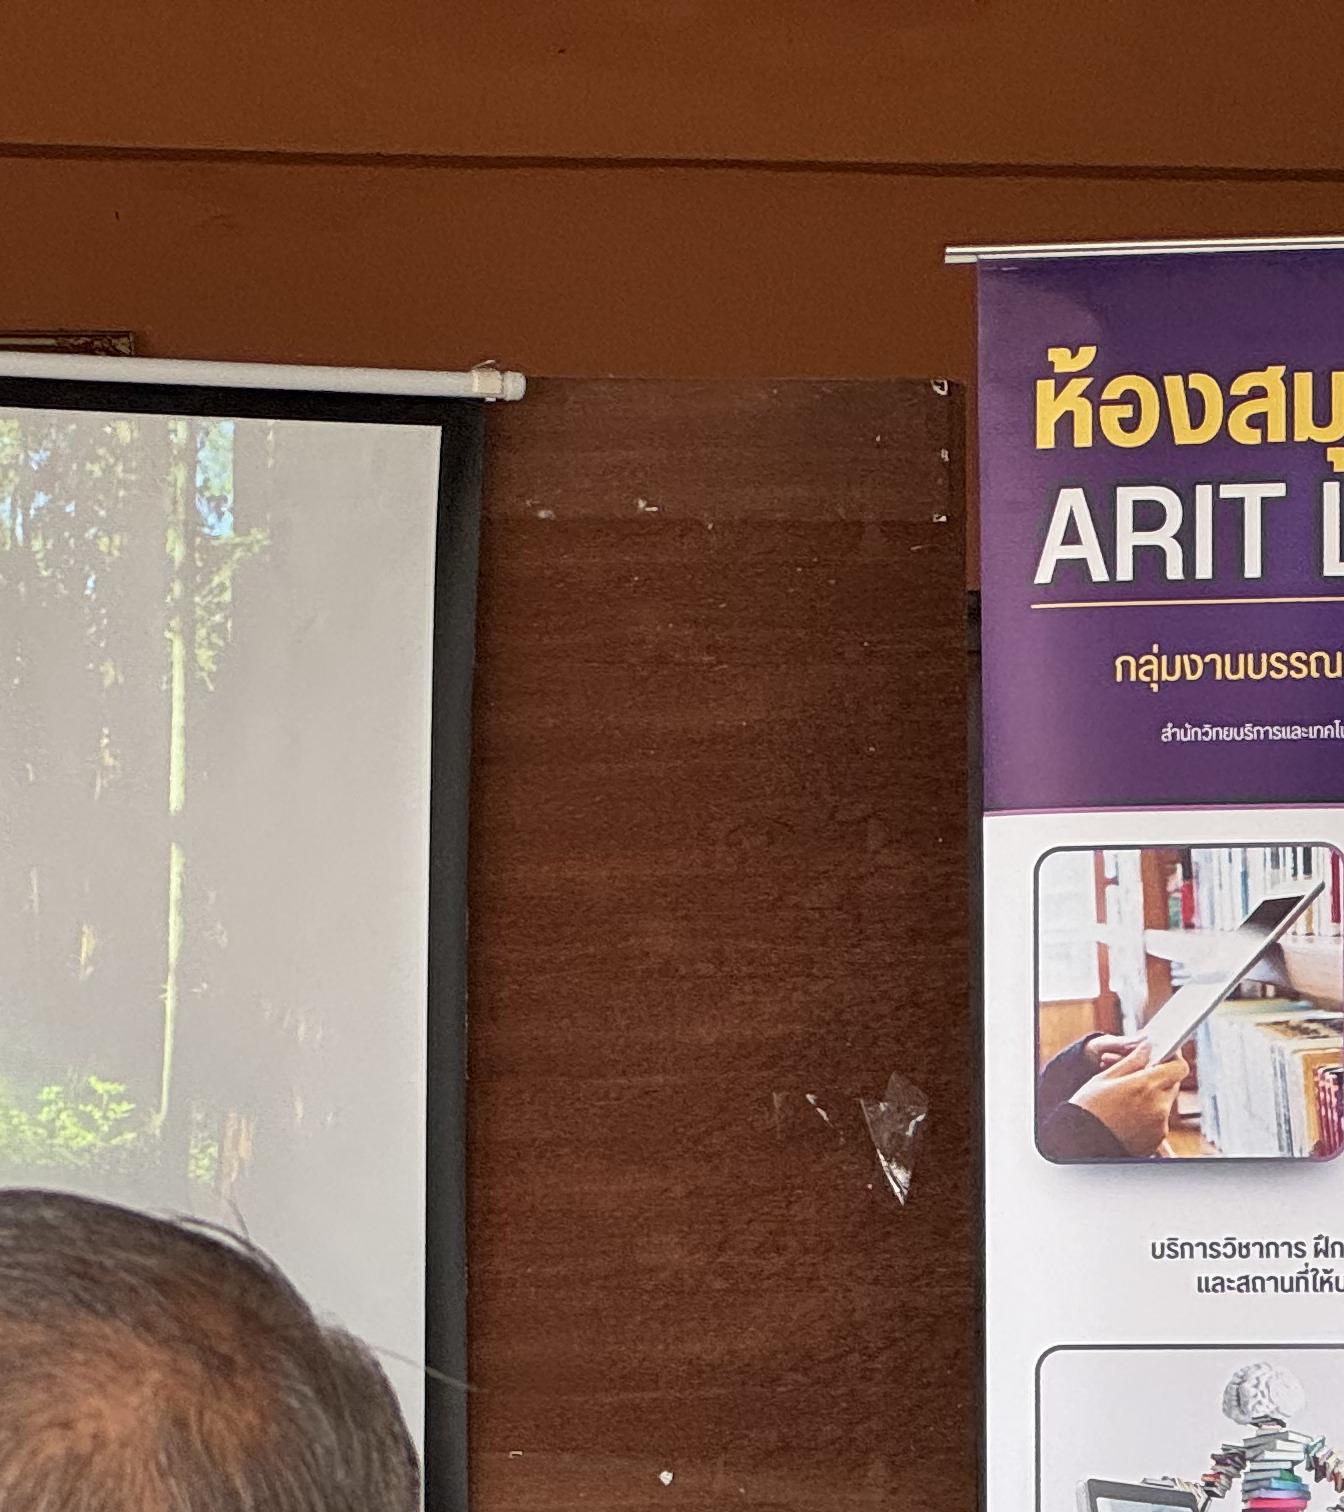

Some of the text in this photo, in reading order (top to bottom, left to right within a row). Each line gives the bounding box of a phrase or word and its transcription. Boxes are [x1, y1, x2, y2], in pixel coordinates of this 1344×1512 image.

[1033, 481, 1287, 585] ARIT
[1160, 719, 1344, 742] สำนักวิทยบริการและเทคโ
[1150, 1236, 1308, 1259] บริการวิชาการ
